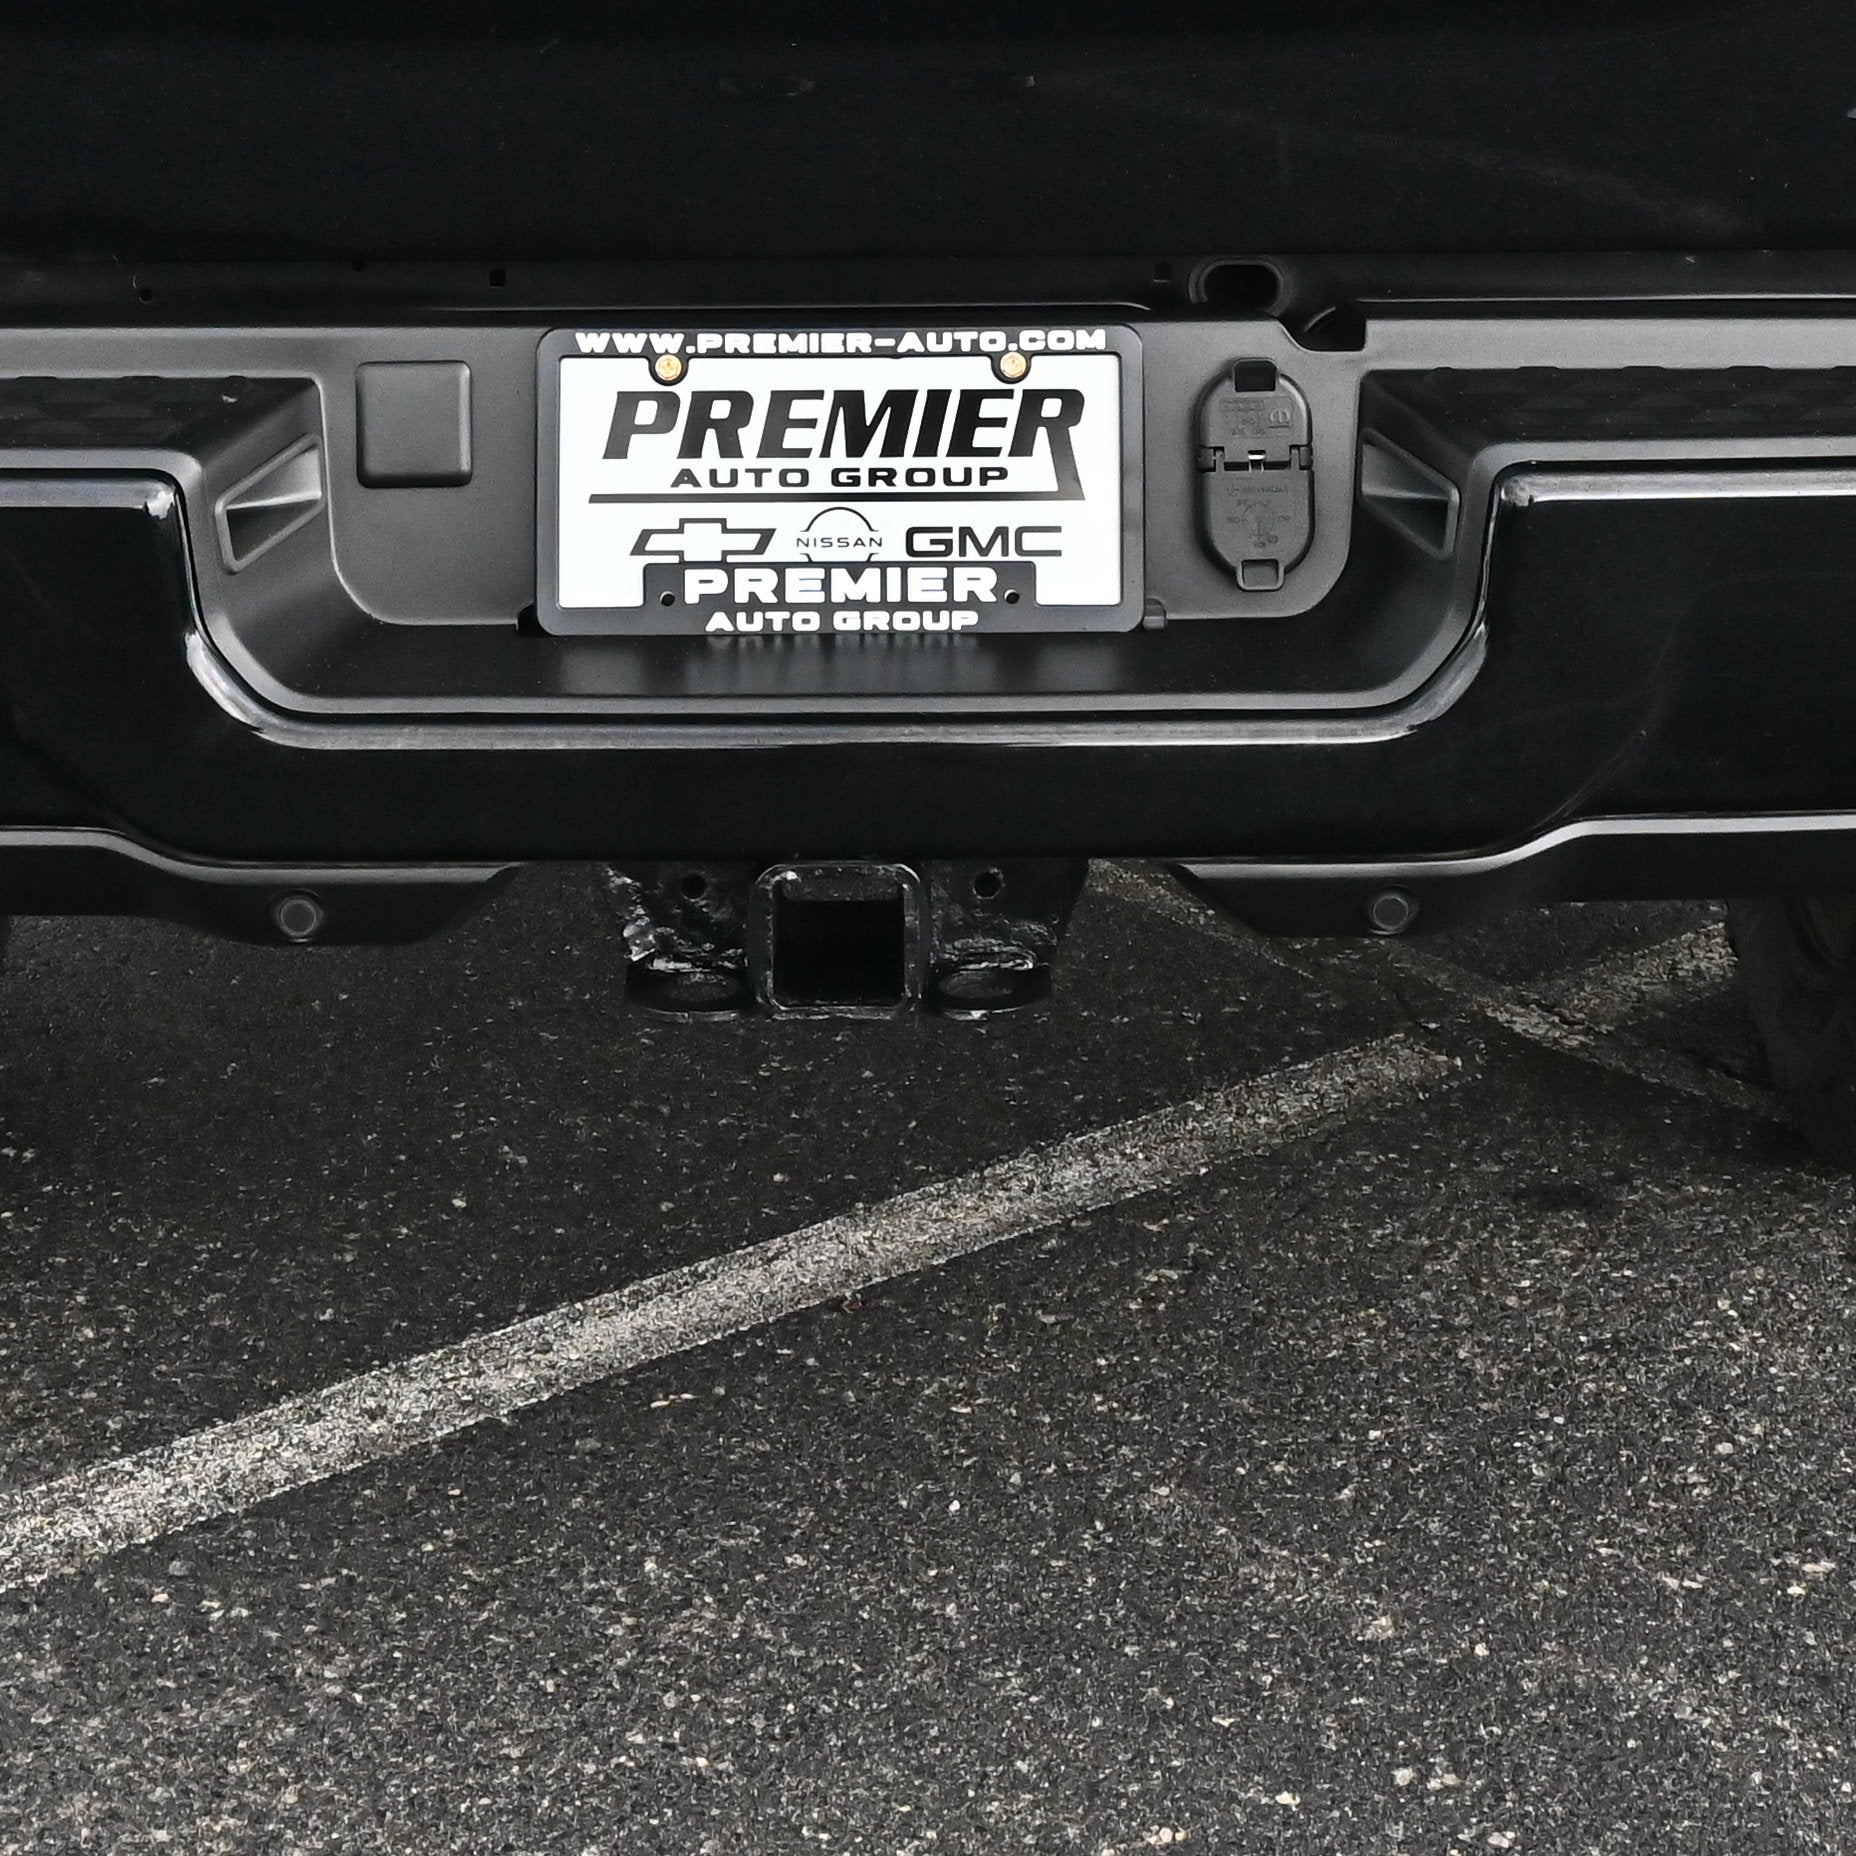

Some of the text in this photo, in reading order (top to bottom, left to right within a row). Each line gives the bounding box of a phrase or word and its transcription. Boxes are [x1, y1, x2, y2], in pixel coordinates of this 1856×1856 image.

[574, 328, 1106, 355] WWW.PREMIER-AUTO.COM
[601, 389, 1086, 501] PREMIER
[670, 467, 1009, 488] AUTO GROUP
[795, 536, 884, 549] NISSAN
[905, 526, 1062, 557] GMC
[683, 566, 998, 605] PREMIER
[705, 610, 980, 633] AUTO GROUP
